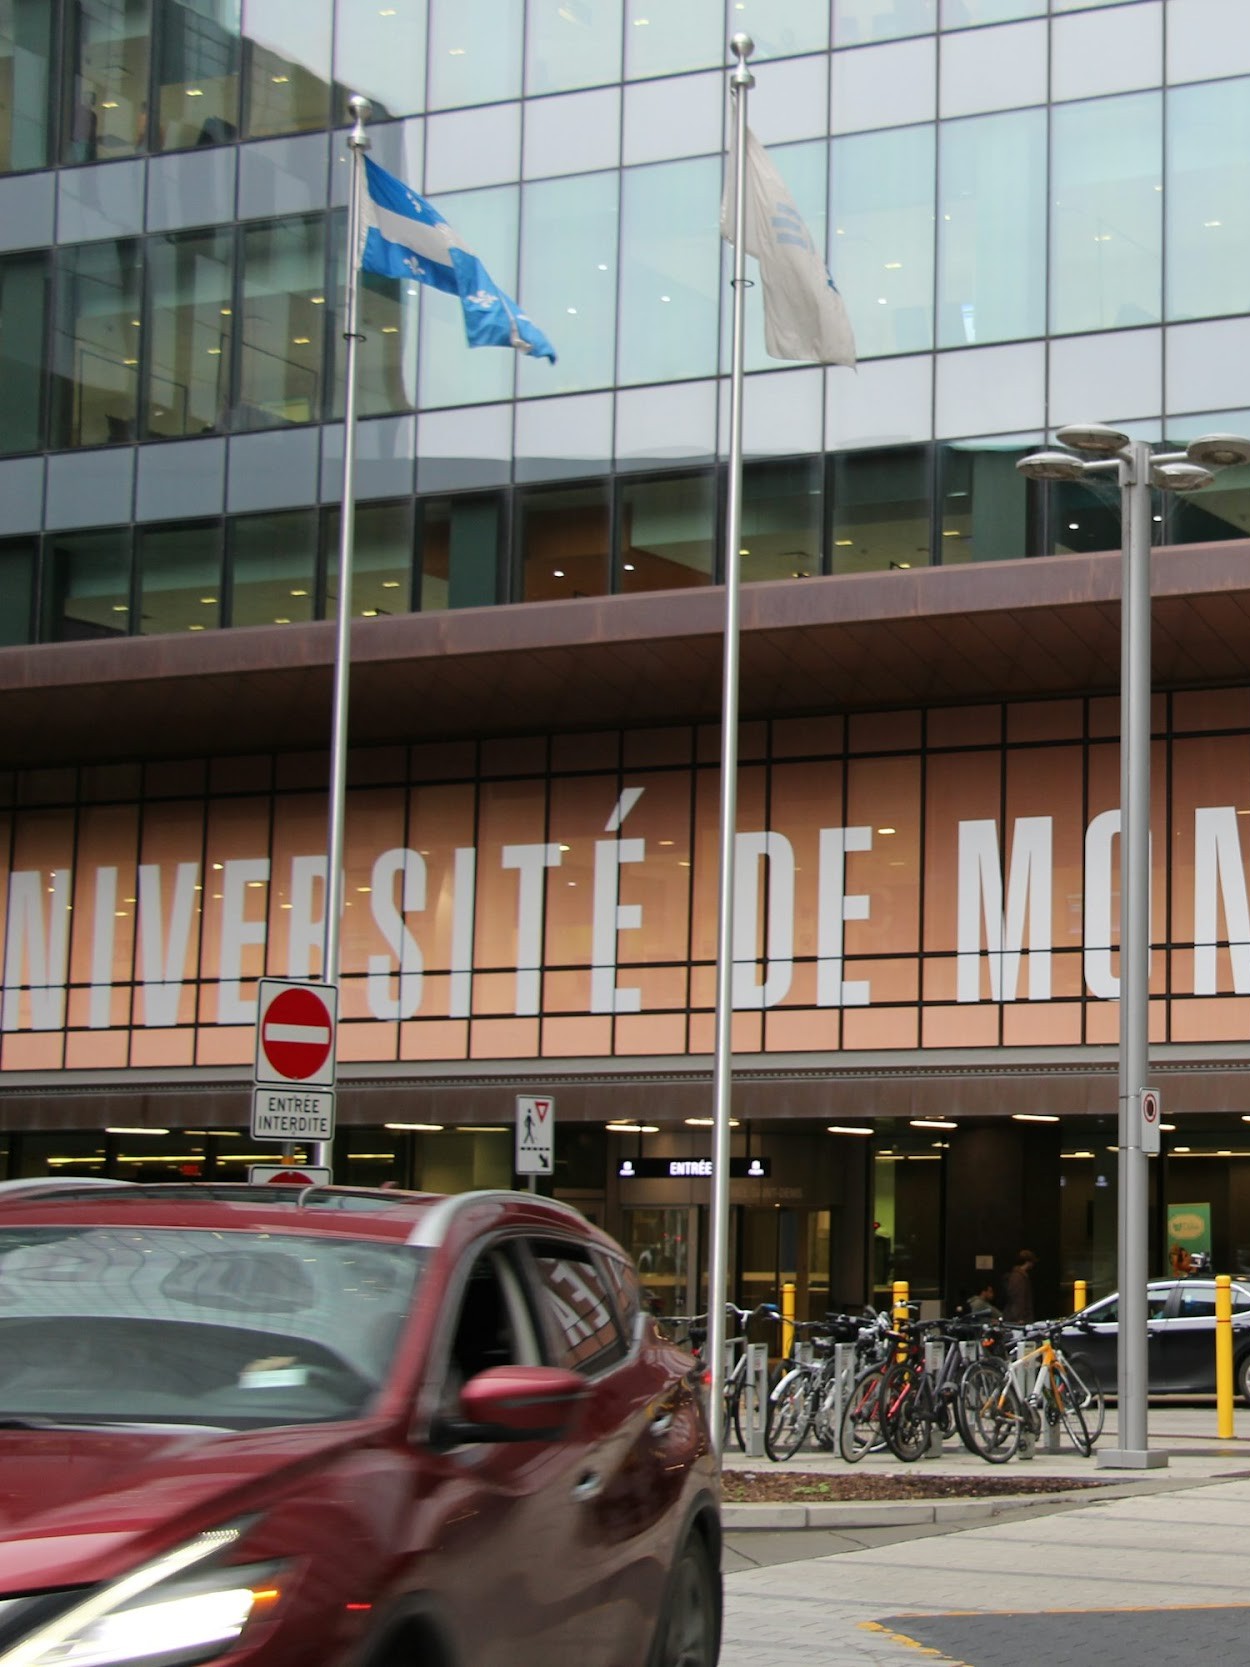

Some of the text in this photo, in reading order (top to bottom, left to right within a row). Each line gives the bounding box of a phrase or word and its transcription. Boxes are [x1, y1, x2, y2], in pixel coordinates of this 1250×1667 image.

[731, 826, 873, 1009] DE
[269, 1095, 319, 1113] ENTRÉE
[258, 1116, 328, 1132] INTERDITE
[669, 1159, 713, 1176] ENTRÉE
